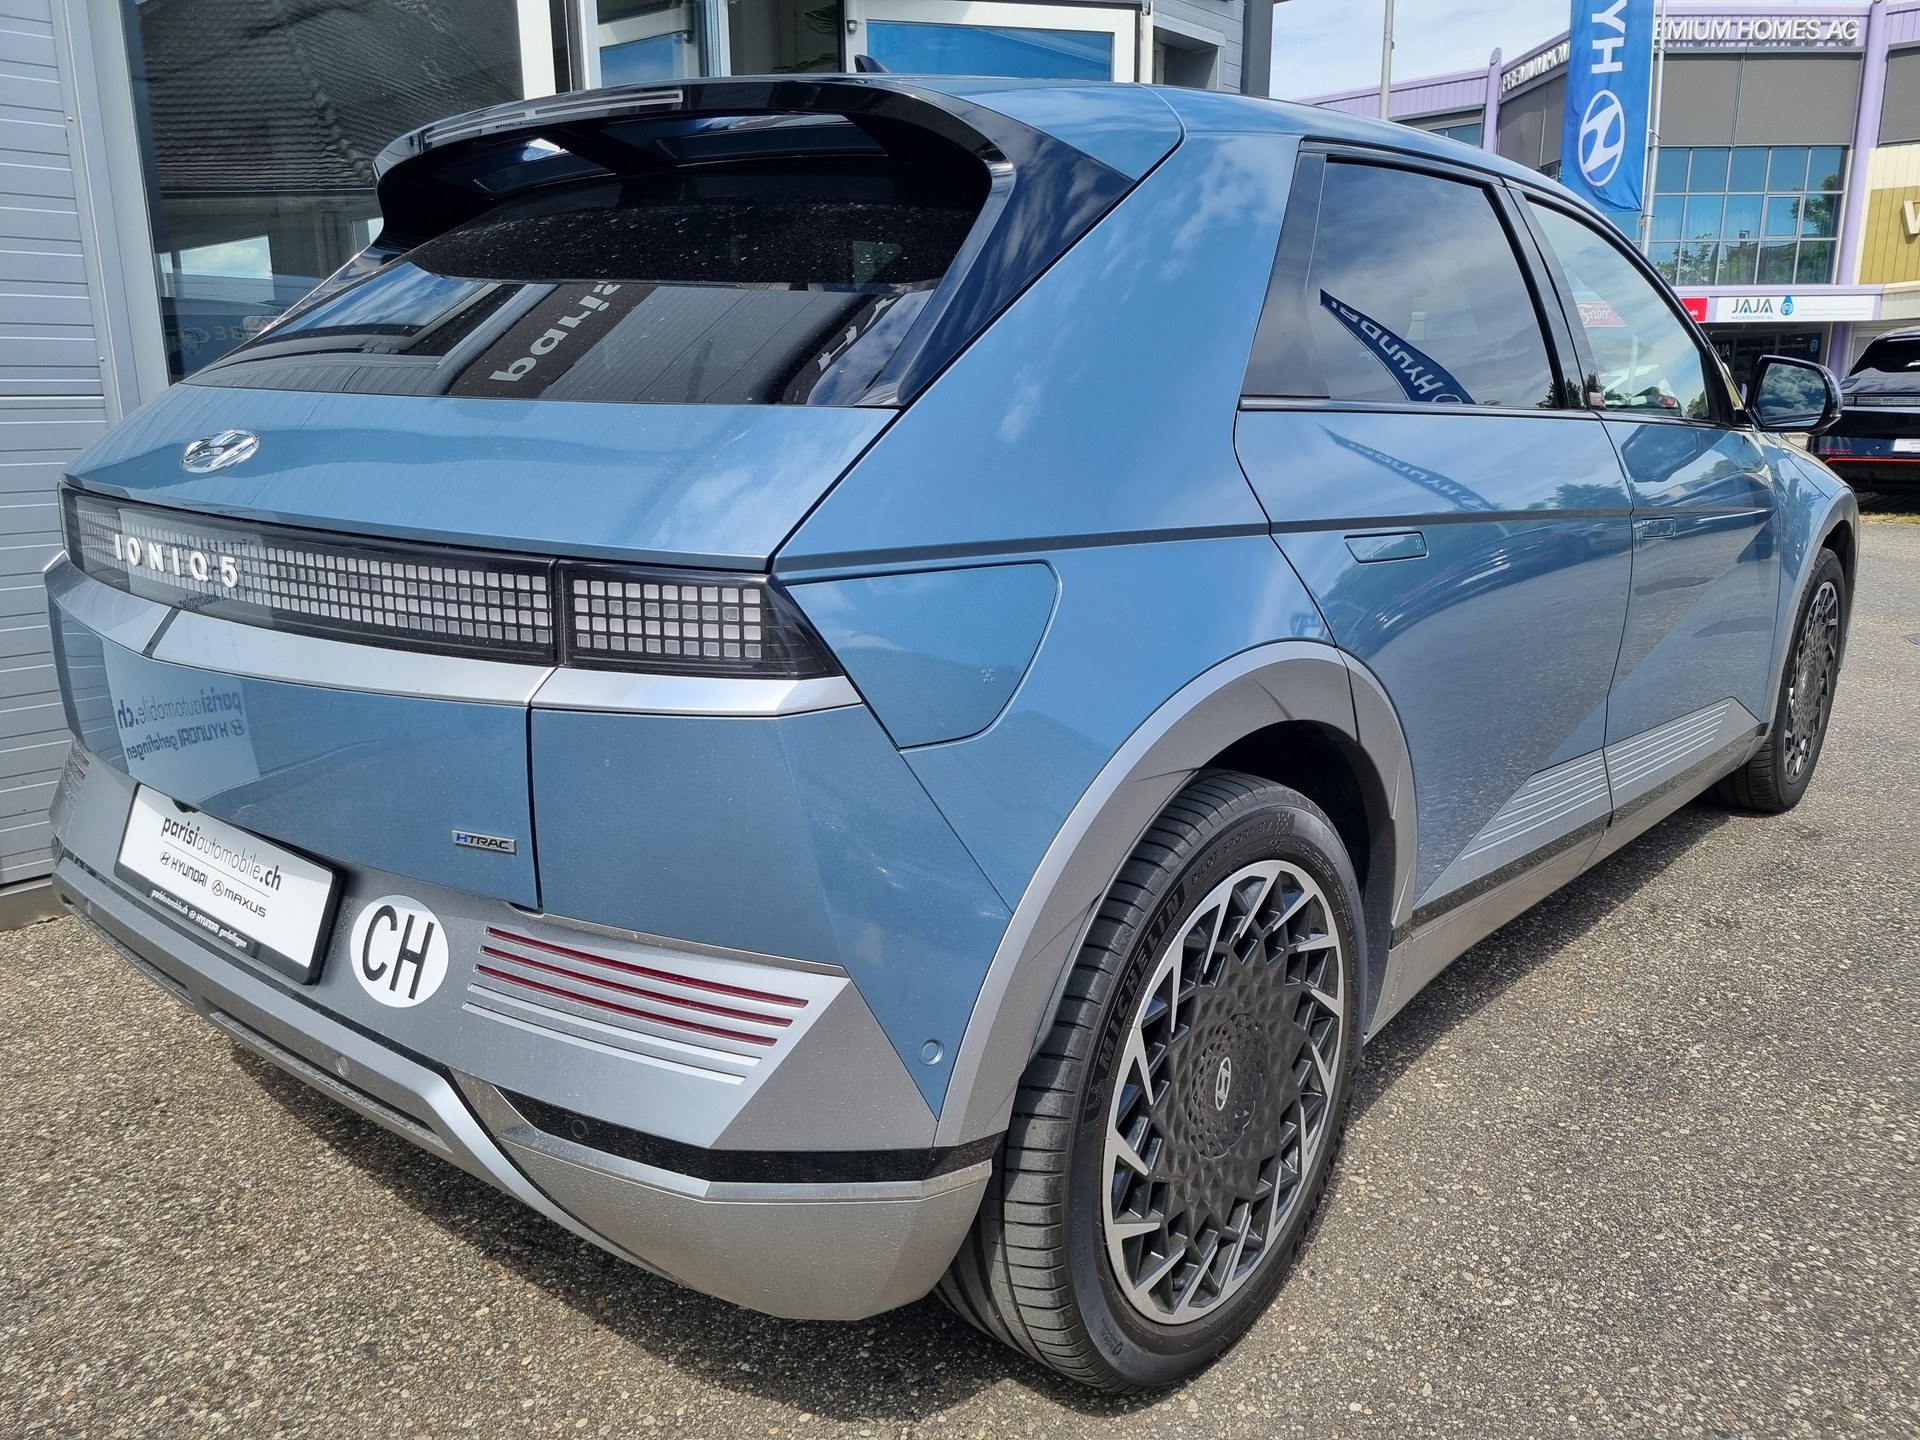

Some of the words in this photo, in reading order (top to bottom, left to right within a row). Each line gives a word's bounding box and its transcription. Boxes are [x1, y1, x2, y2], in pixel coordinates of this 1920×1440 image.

[1737, 19, 1821, 40] HOMES
[1825, 19, 1859, 40] AG
[1732, 298, 1774, 314] JAJA
[114, 534, 210, 582] IONIQ
[220, 555, 239, 588] 5
[160, 817, 282, 891] parisiautomobile.ch
[456, 833, 510, 849] HTRAC
[171, 856, 208, 888] HYUNDAI
[196, 913, 220, 934] HYUNDAI
[362, 905, 435, 1000] CH
[1099, 897, 1181, 1071] MICHELIN
